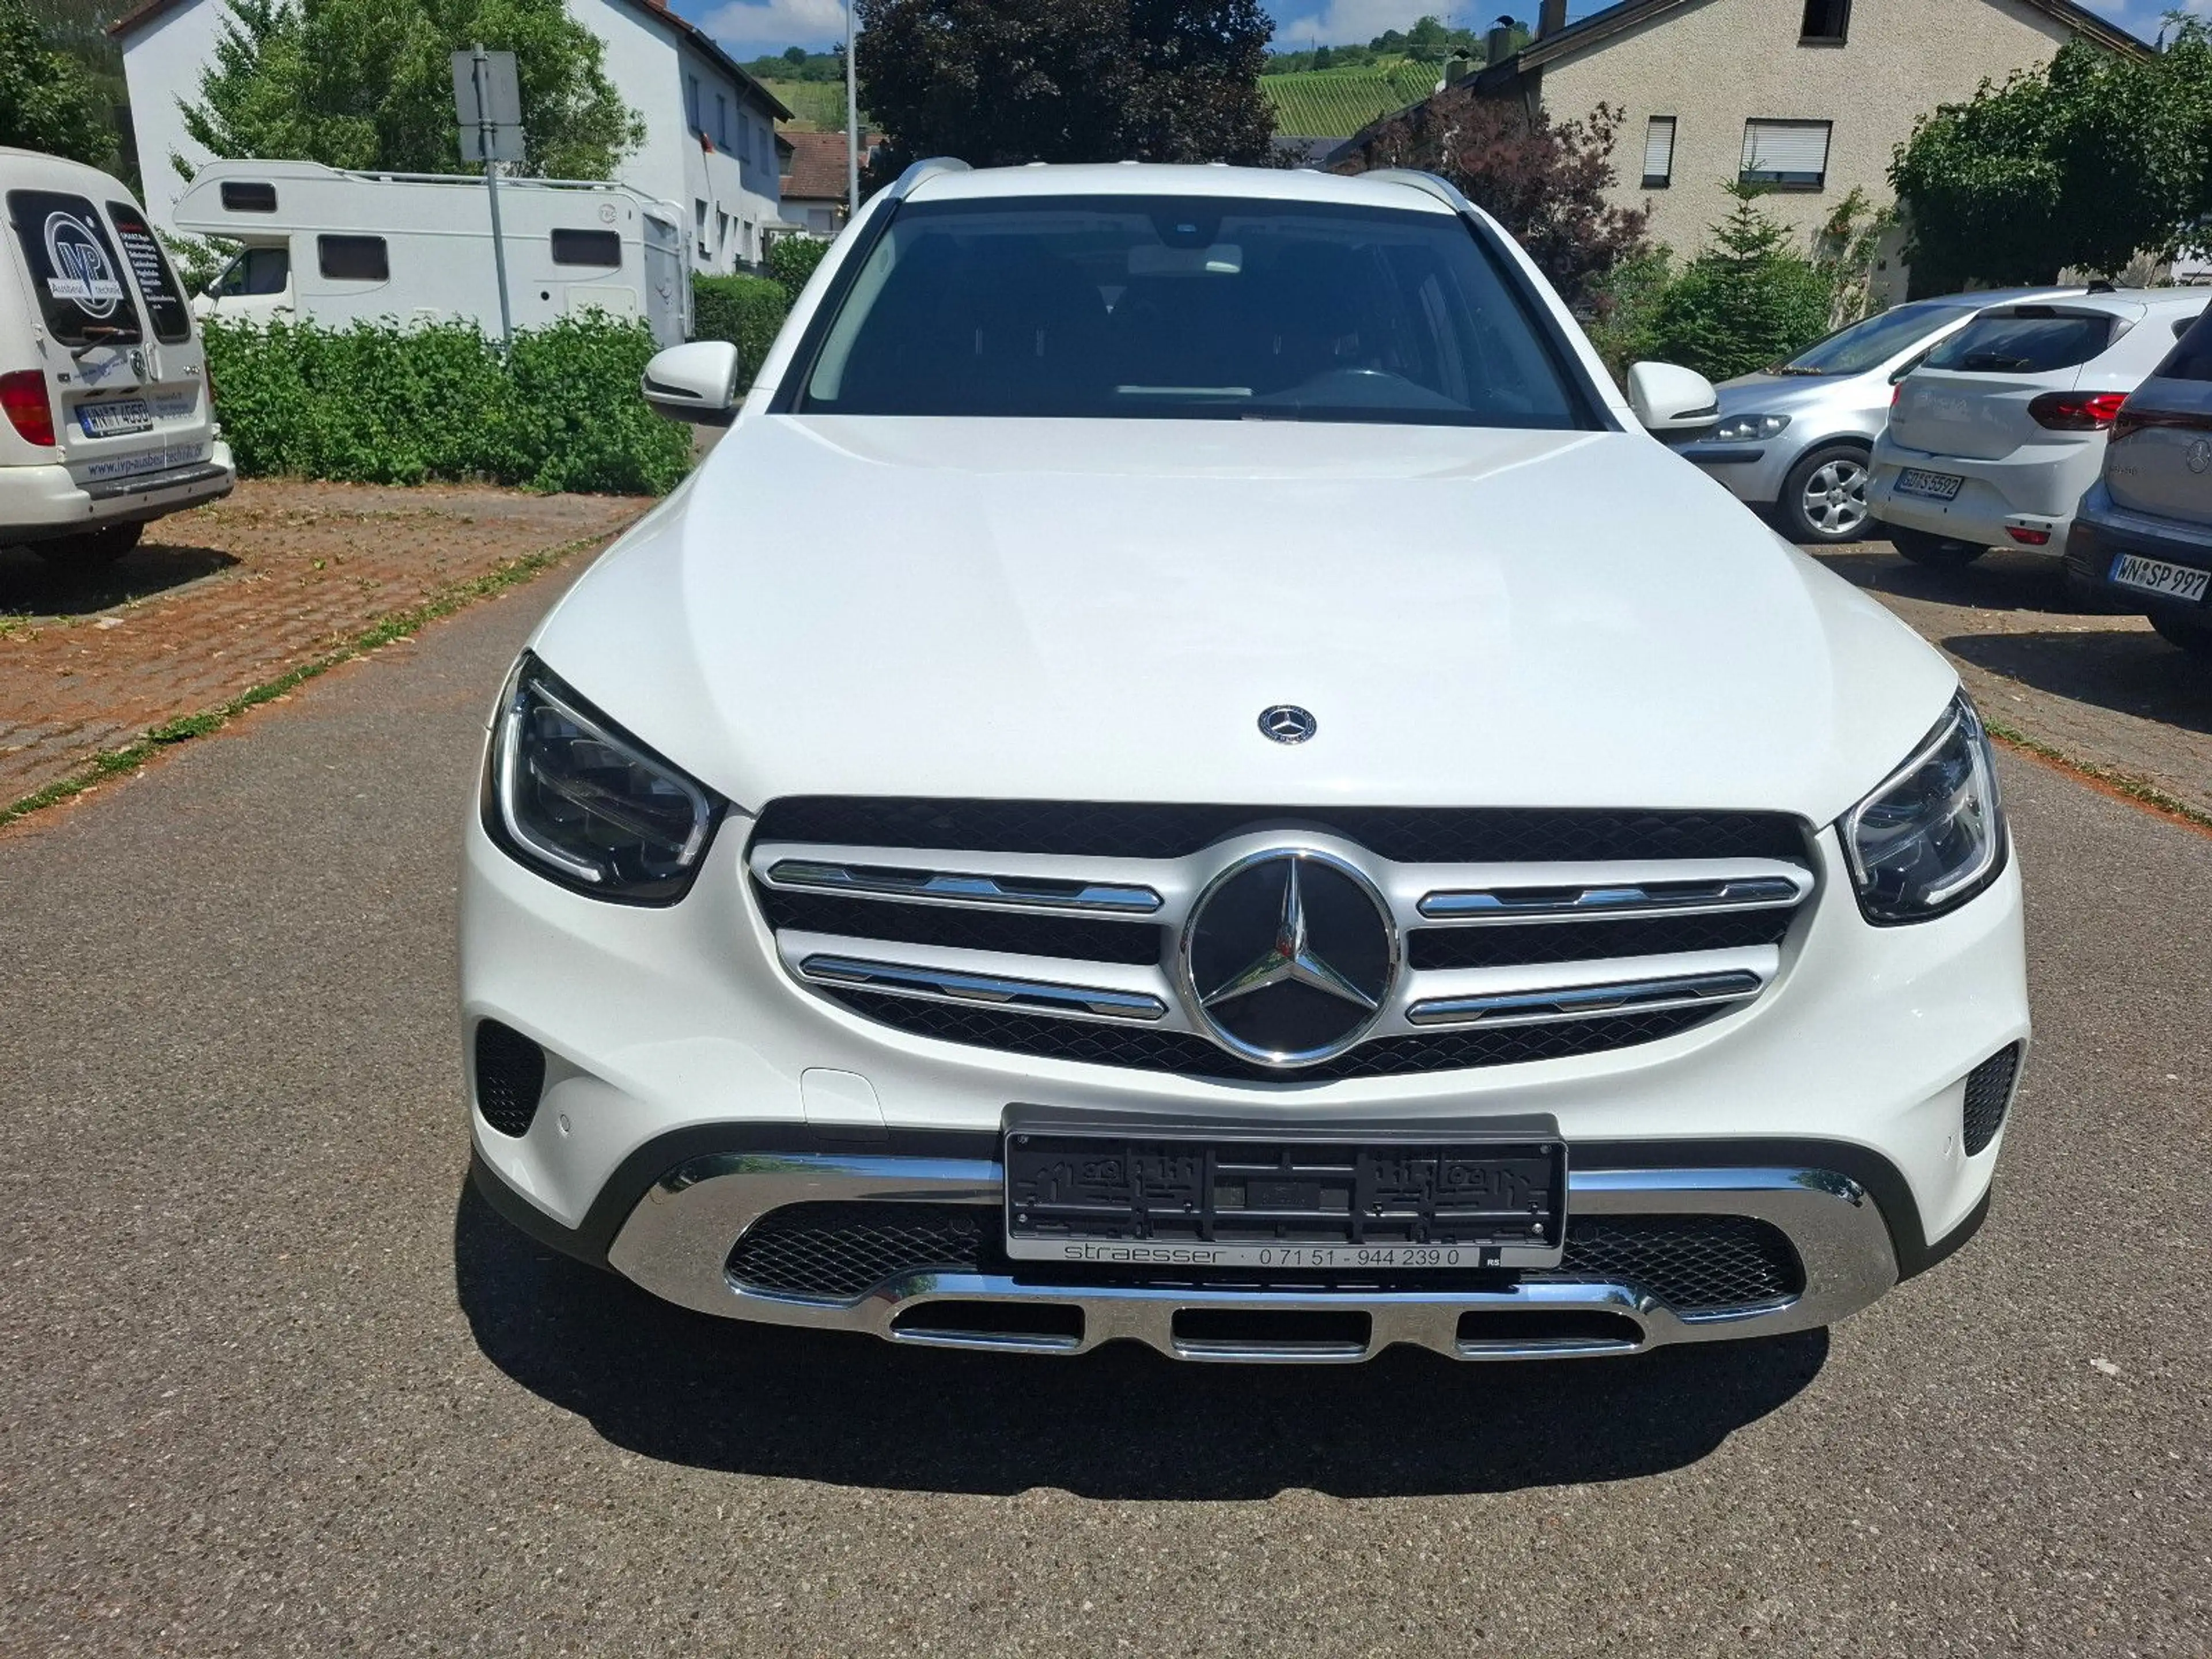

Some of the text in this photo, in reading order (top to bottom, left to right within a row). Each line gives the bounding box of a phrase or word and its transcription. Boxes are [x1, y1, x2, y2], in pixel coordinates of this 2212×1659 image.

[2118, 556, 2206, 596] WN SP 997
[1065, 1243, 1228, 1263] straesser
[1358, 1249, 1395, 1266] 944
